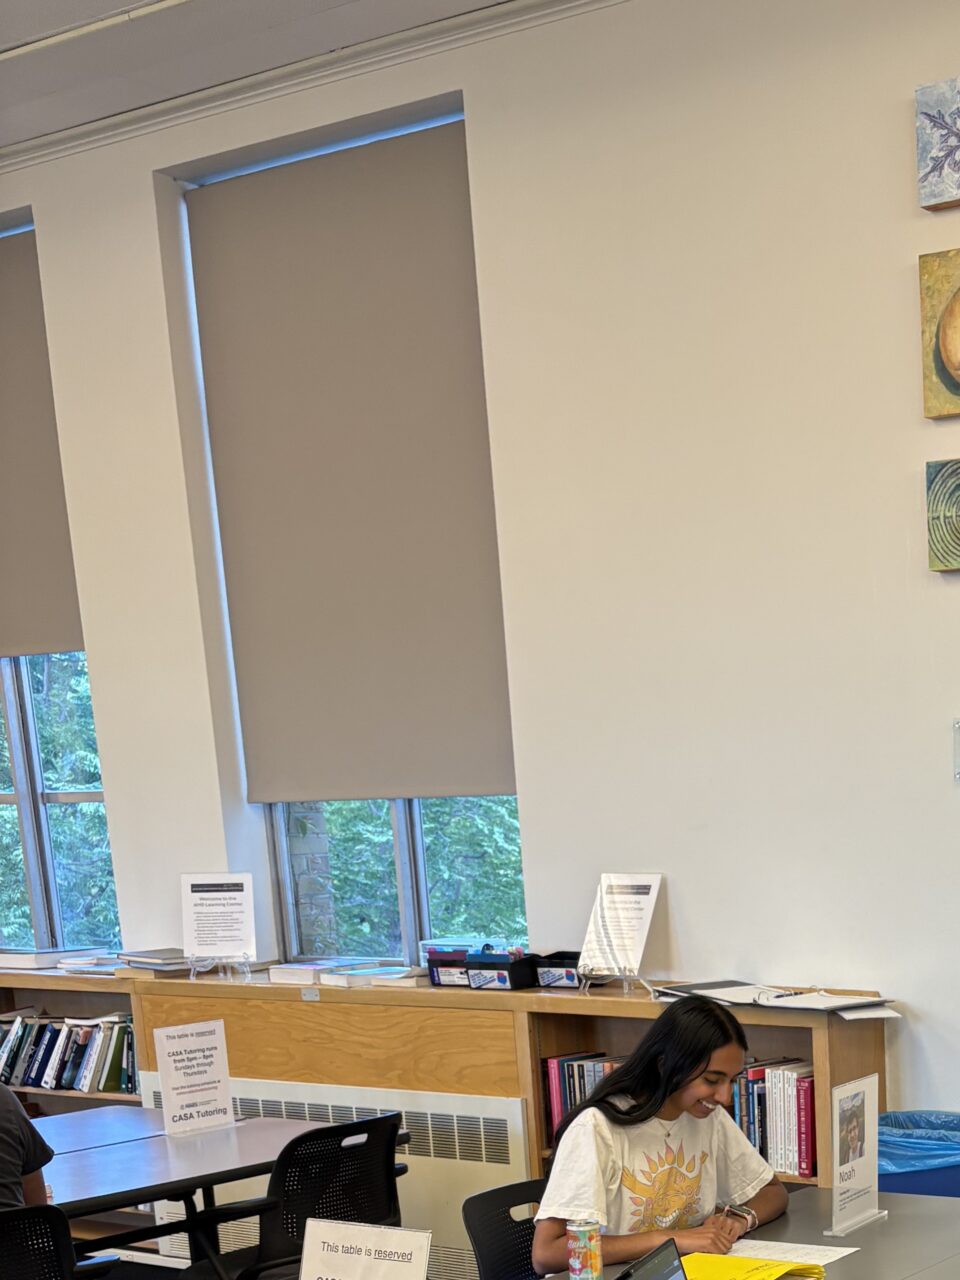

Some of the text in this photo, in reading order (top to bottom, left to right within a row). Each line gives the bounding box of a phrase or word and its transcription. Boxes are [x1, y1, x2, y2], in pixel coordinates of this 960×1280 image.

[168, 1050, 183, 1058] CASA
[171, 1107, 228, 1123] CASA Tutoring
[839, 1166, 856, 1184] Noah
[321, 1241, 412, 1262] This table is reserved
